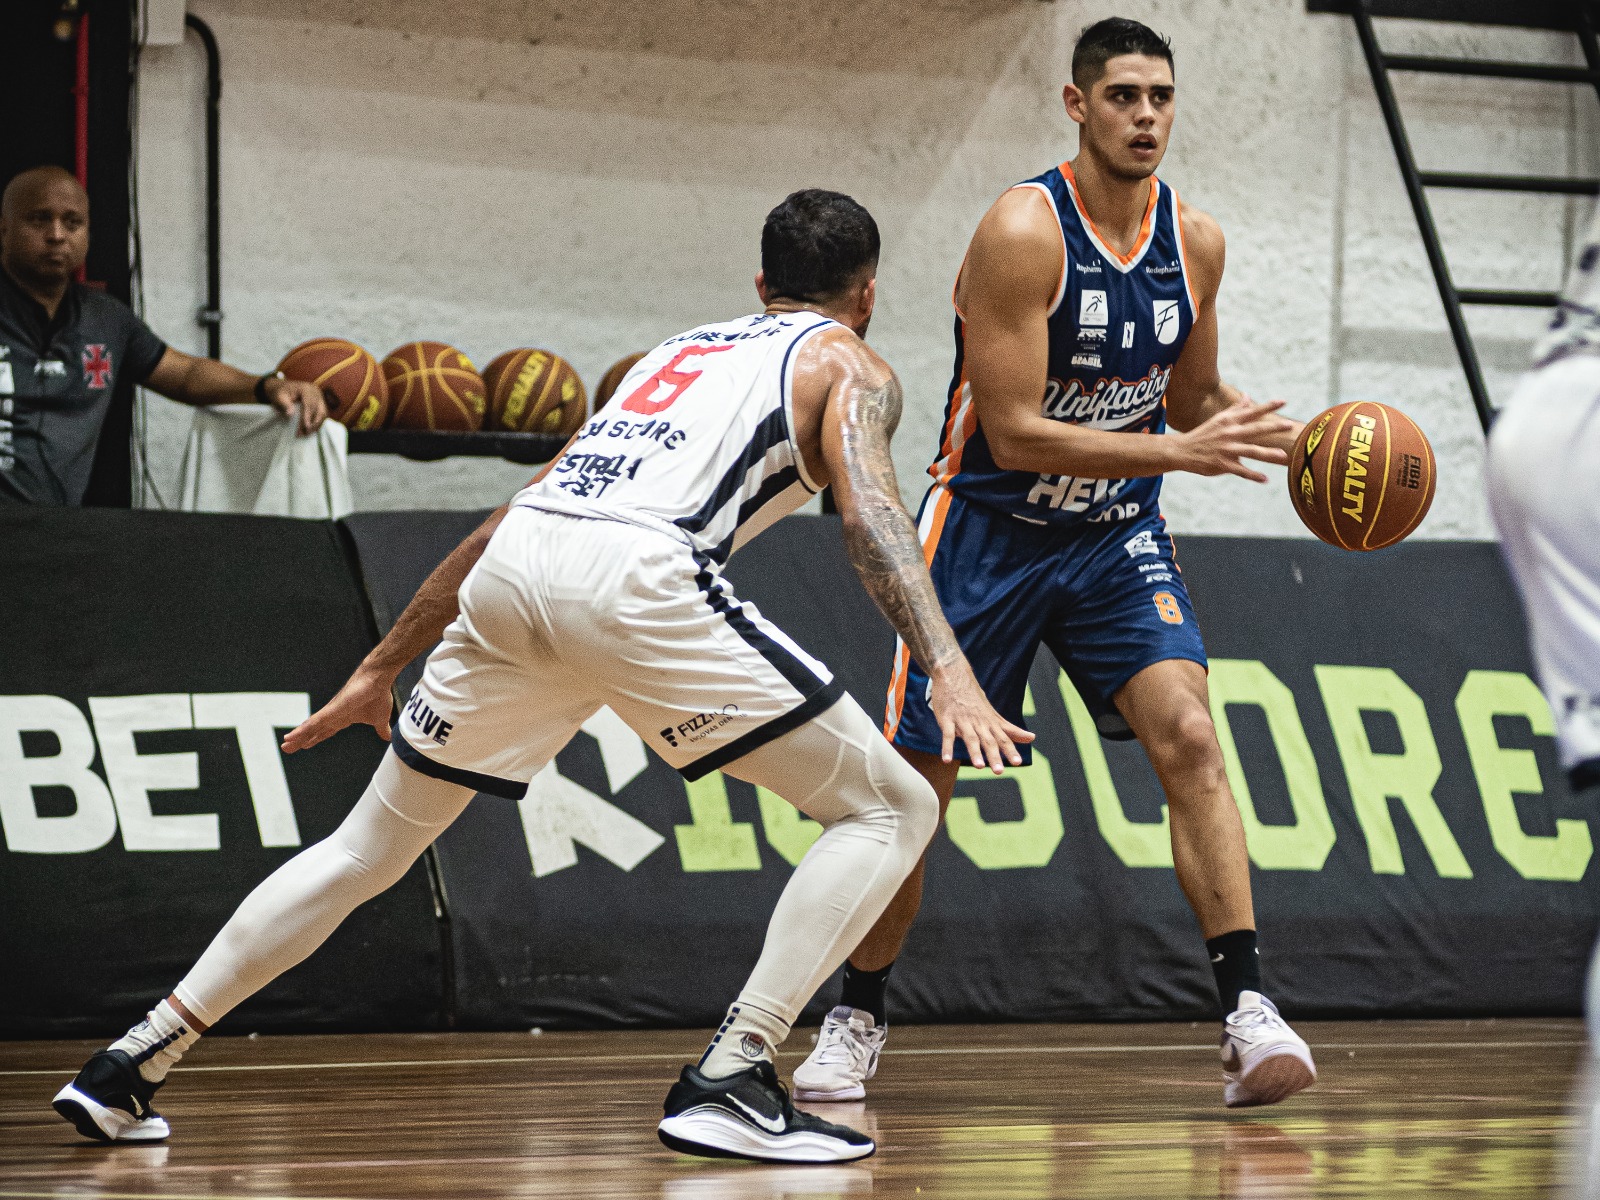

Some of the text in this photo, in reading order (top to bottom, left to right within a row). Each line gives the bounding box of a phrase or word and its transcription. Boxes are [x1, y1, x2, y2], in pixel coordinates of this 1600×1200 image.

[620, 344, 736, 415] 6
[1341, 413, 1377, 524] PENALTY
[1407, 454, 1421, 489] FIBA
[1152, 591, 1184, 625] 8
[0, 693, 309, 854] BET
[945, 657, 1594, 882] SCORE
